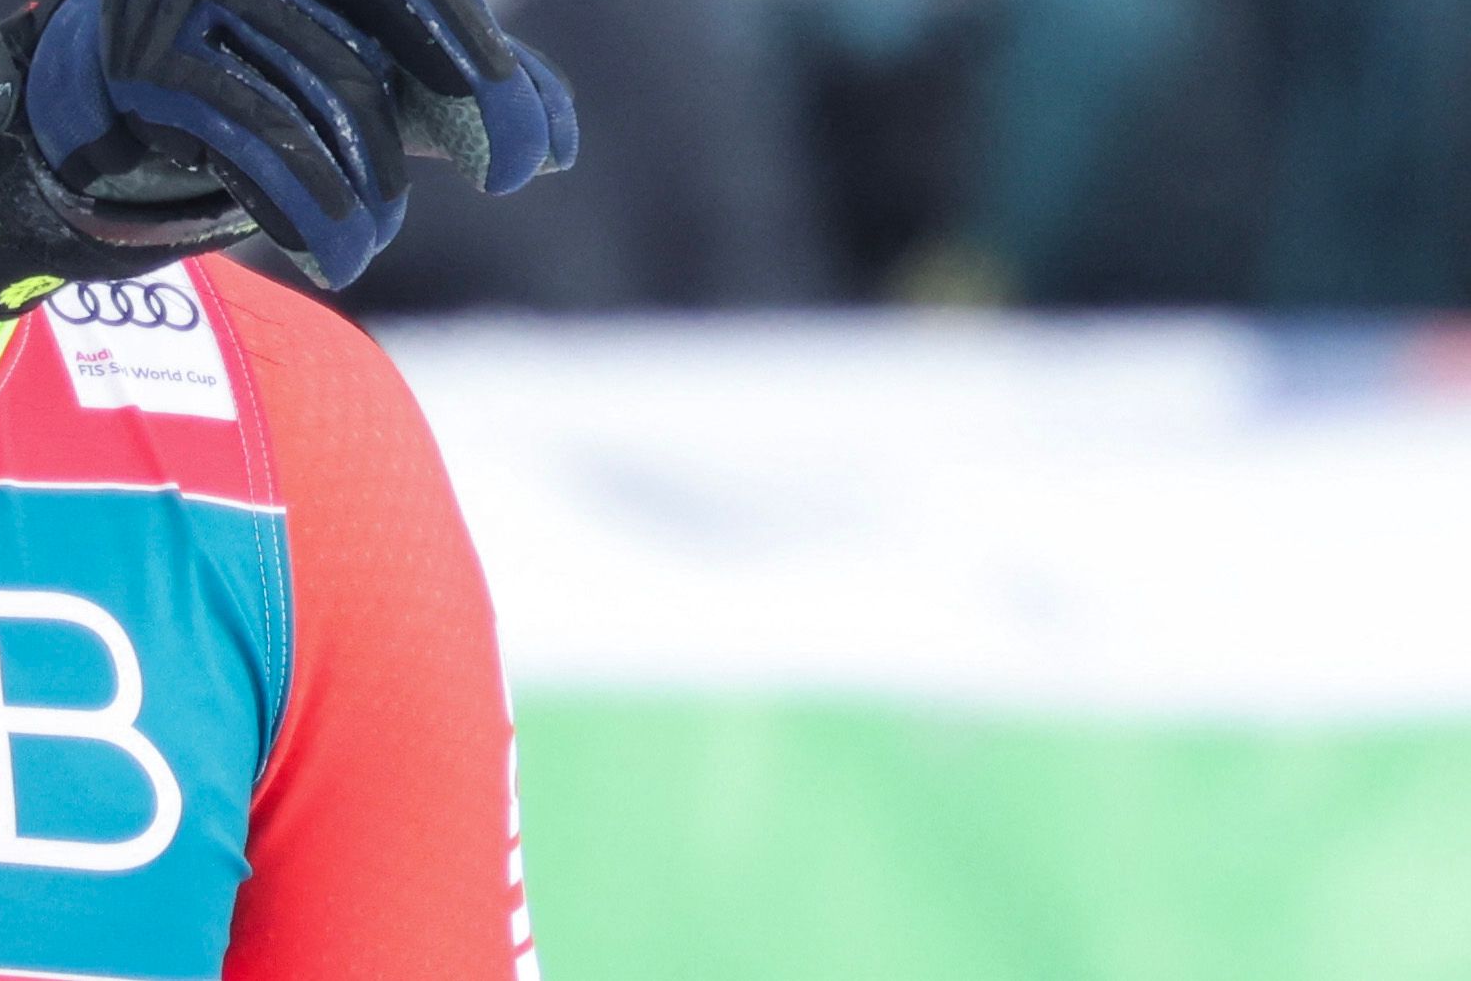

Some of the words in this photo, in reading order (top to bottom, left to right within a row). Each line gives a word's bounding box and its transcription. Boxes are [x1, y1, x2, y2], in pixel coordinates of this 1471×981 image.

[75, 348, 113, 362] Audi
[78, 363, 106, 376] FIS
[131, 366, 183, 382] World
[186, 370, 218, 387] Cup
